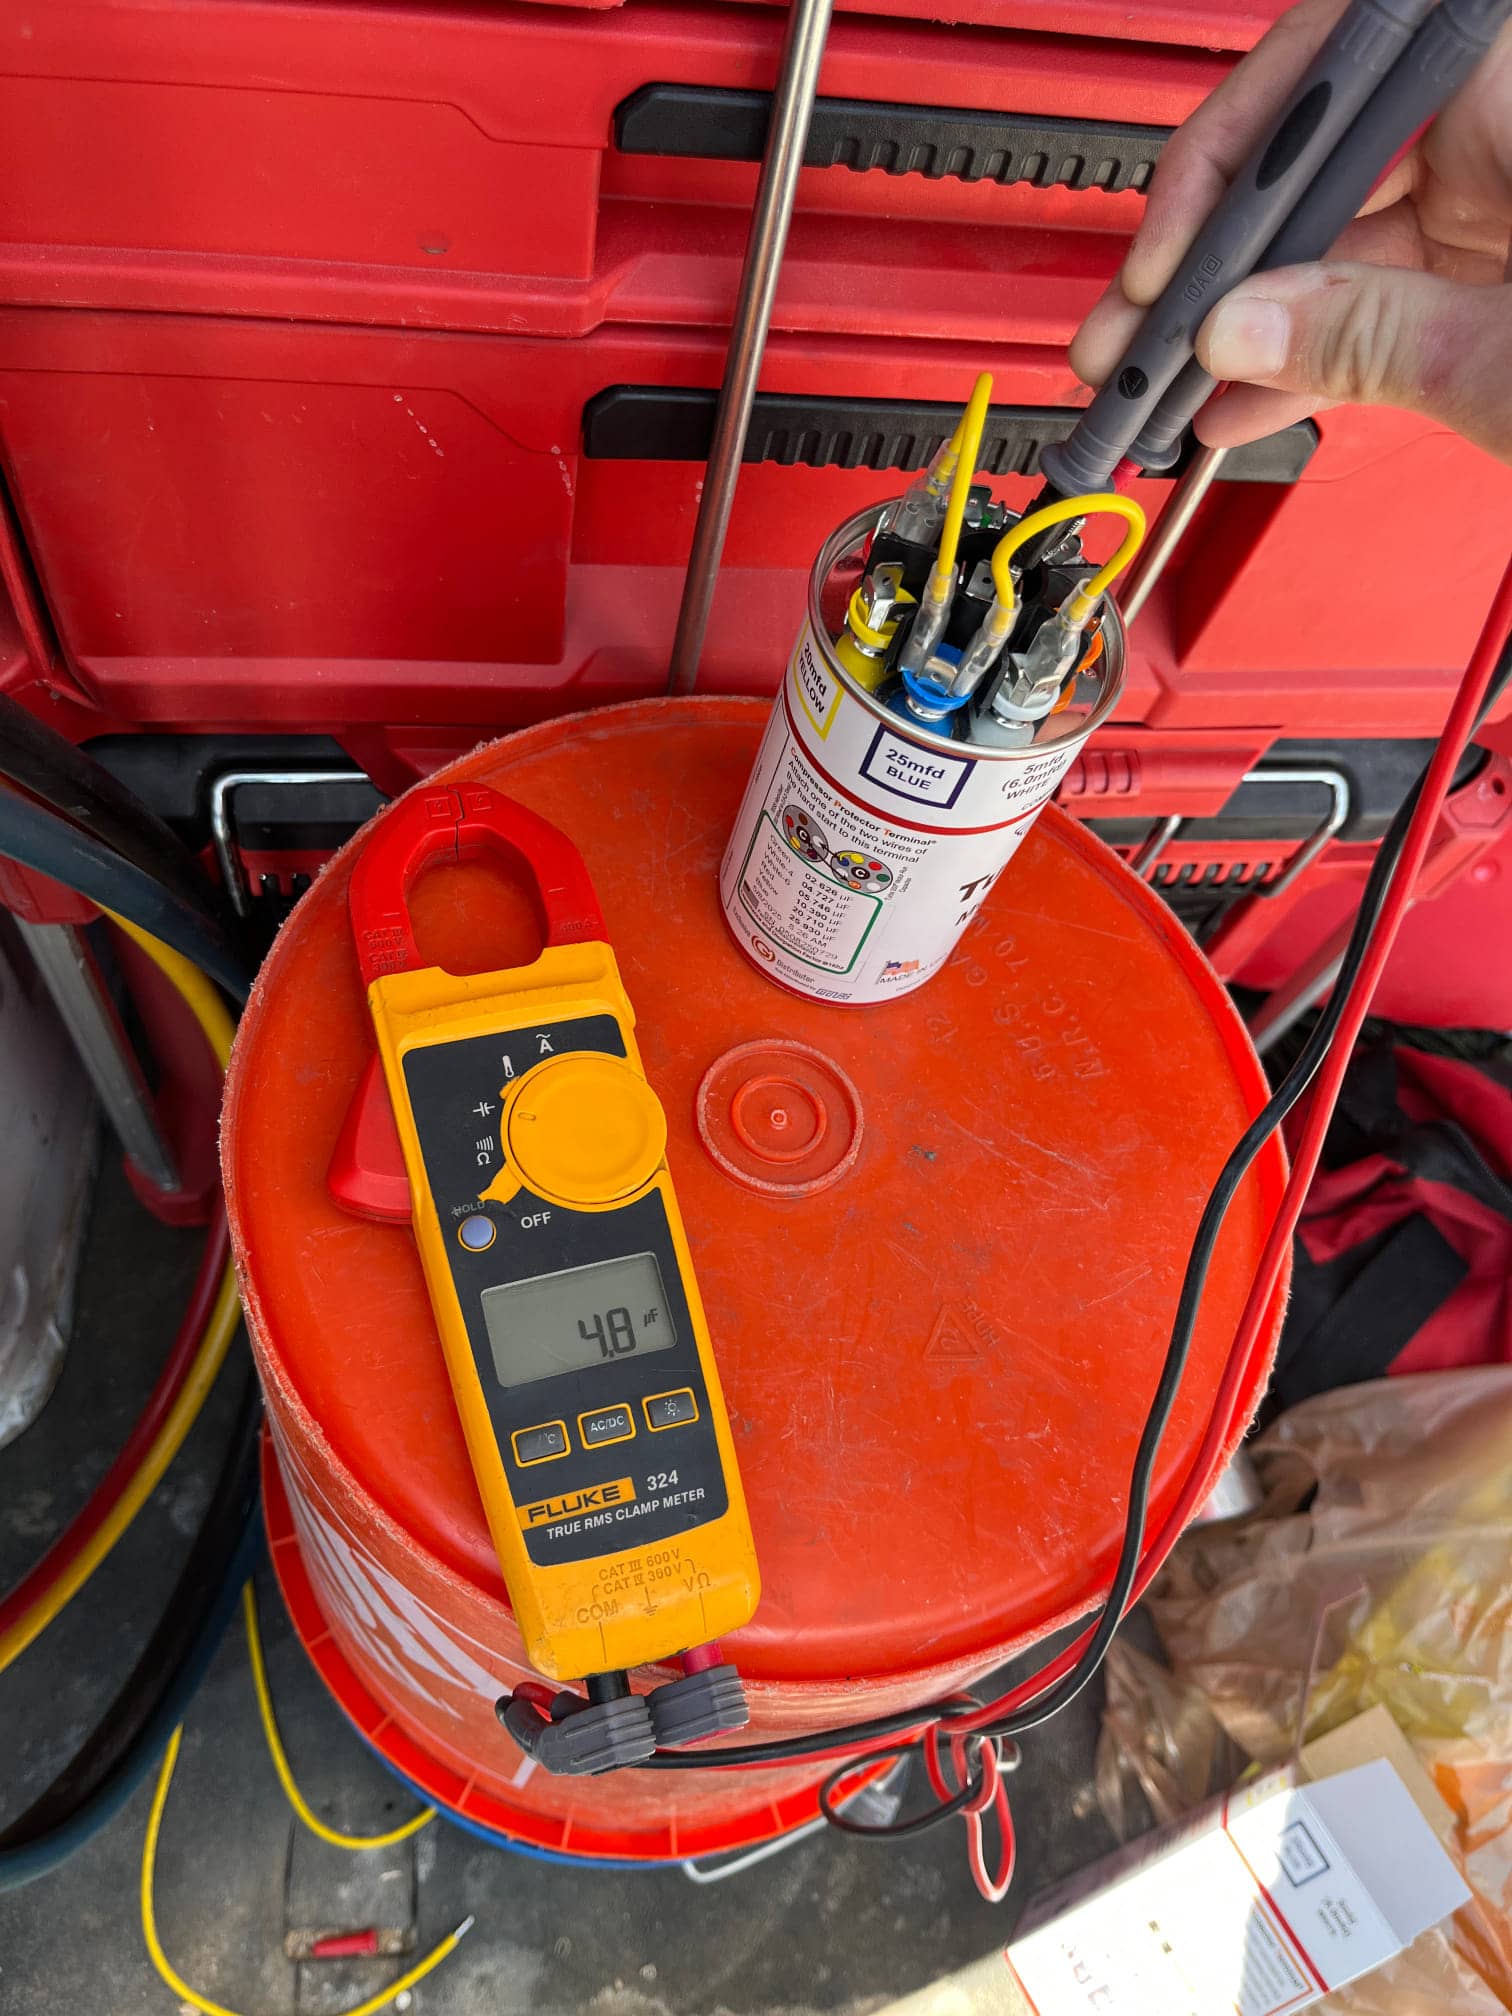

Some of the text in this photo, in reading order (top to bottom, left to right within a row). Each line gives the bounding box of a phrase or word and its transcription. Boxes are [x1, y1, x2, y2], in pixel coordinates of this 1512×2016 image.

[804, 642, 827, 697] 20mfd
[885, 748, 946, 779] 25mfd
[1023, 752, 1065, 775] 5mfd
[791, 747, 833, 802] Compressor
[834, 799, 881, 832] Protector
[886, 765, 932, 791] BLUE
[1006, 779, 1050, 800] WHITE
[796, 787, 816, 812] hard
[816, 809, 840, 831] start
[839, 827, 850, 838] to
[851, 833, 871, 849] this
[873, 844, 920, 863] terminal
[810, 791, 827, 810] one
[828, 807, 840, 819] of
[840, 814, 857, 832] the
[859, 828, 879, 842] two
[882, 839, 912, 854] wires
[914, 847, 928, 856] of
[520, 1210, 551, 1229] OFF
[577, 1306, 637, 1358] 4.8
[590, 1414, 625, 1433] AC/DC
[646, 1470, 679, 1491] 324
[527, 1485, 621, 1523] FLUKE
[546, 1487, 706, 1540] TRUE RMS CLAMP METER
[598, 1562, 625, 1581] CAT
[603, 1576, 631, 1595] CAT
[576, 1598, 619, 1624] COM
